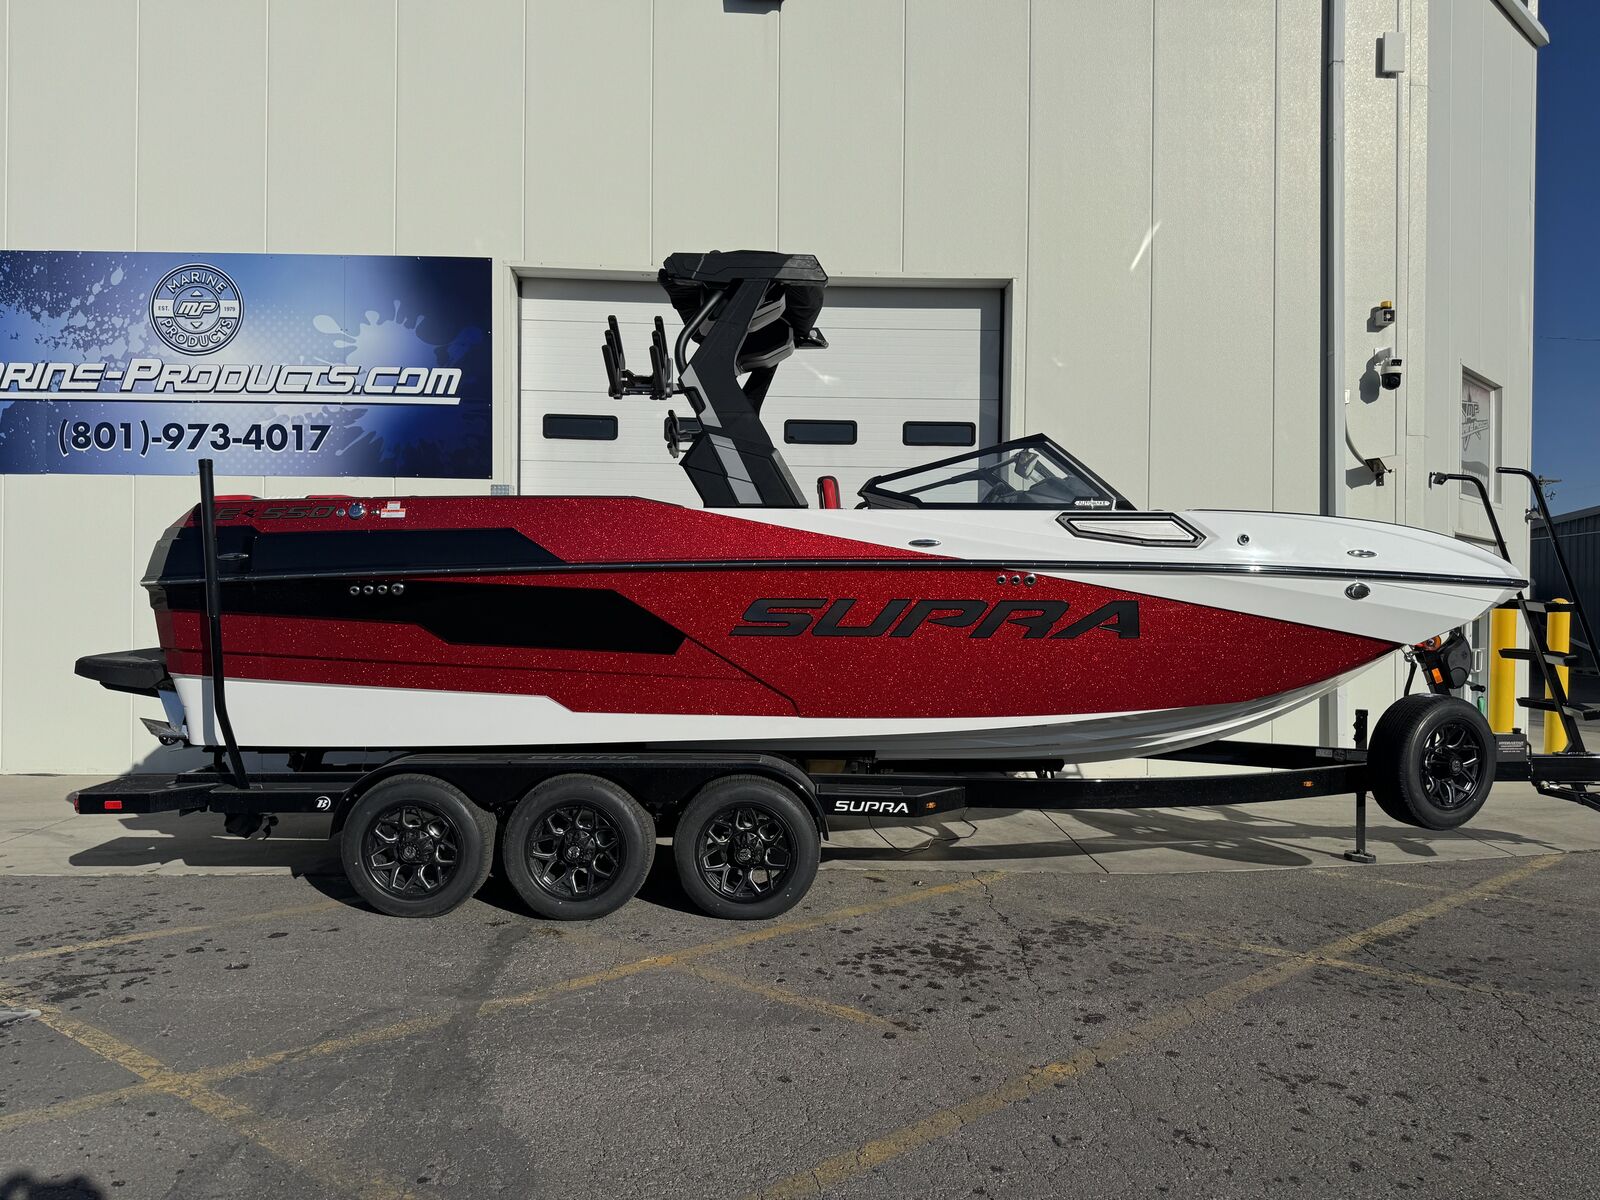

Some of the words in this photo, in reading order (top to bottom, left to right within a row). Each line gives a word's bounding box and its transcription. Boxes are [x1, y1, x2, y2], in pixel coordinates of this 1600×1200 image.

[166, 271, 228, 295] MARINE
[174, 300, 219, 319] MP
[160, 318, 233, 348] PRODUCTS
[0, 357, 463, 395] RINE-PRODUCTS.COM
[57, 418, 333, 458] (801)-973-4017
[728, 598, 1141, 640] SUPRA
[834, 799, 910, 814] SUPRA
